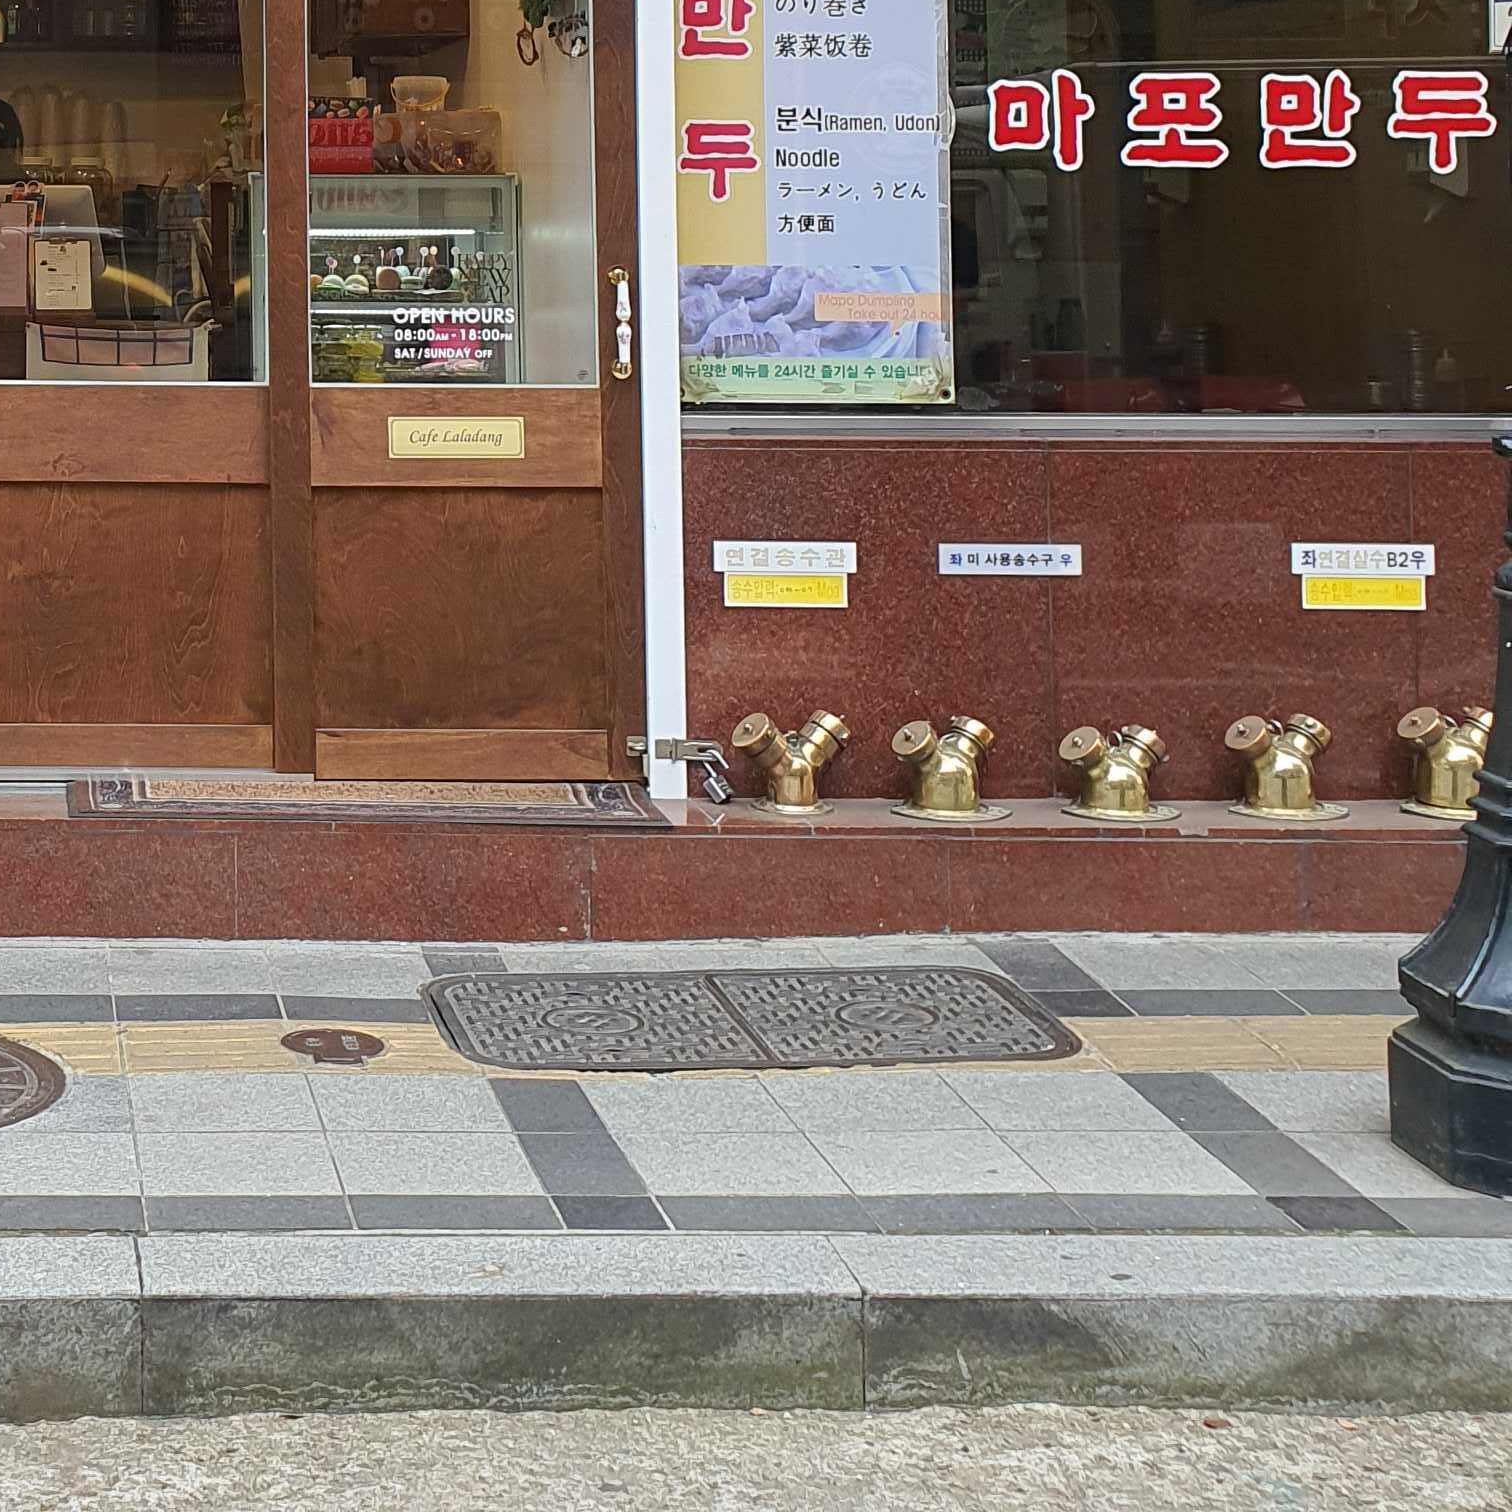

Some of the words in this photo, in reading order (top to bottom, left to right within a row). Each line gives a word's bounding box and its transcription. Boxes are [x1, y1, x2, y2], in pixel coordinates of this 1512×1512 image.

[775, 33, 872, 58] 紫菜饭卷
[895, 115, 940, 132] Udon)
[987, 68, 1498, 175] 마포만두
[775, 148, 840, 167] Noodle
[873, 182, 927, 200] うどん
[778, 213, 835, 233] 方便面
[858, 294, 915, 308] Dumpling
[393, 308, 445, 324] OPEN
[451, 308, 515, 324] HOURS
[475, 349, 493, 359] OFF
[688, 363, 727, 378] 다양한
[732, 363, 769, 378] 메뉴를
[775, 363, 815, 378] 24시간
[821, 364, 858, 379] 즐기실
[863, 364, 877, 378] 수
[409, 429, 439, 447] Cafe
[442, 428, 503, 446] Laladang
[725, 548, 846, 568] 연결송수관
